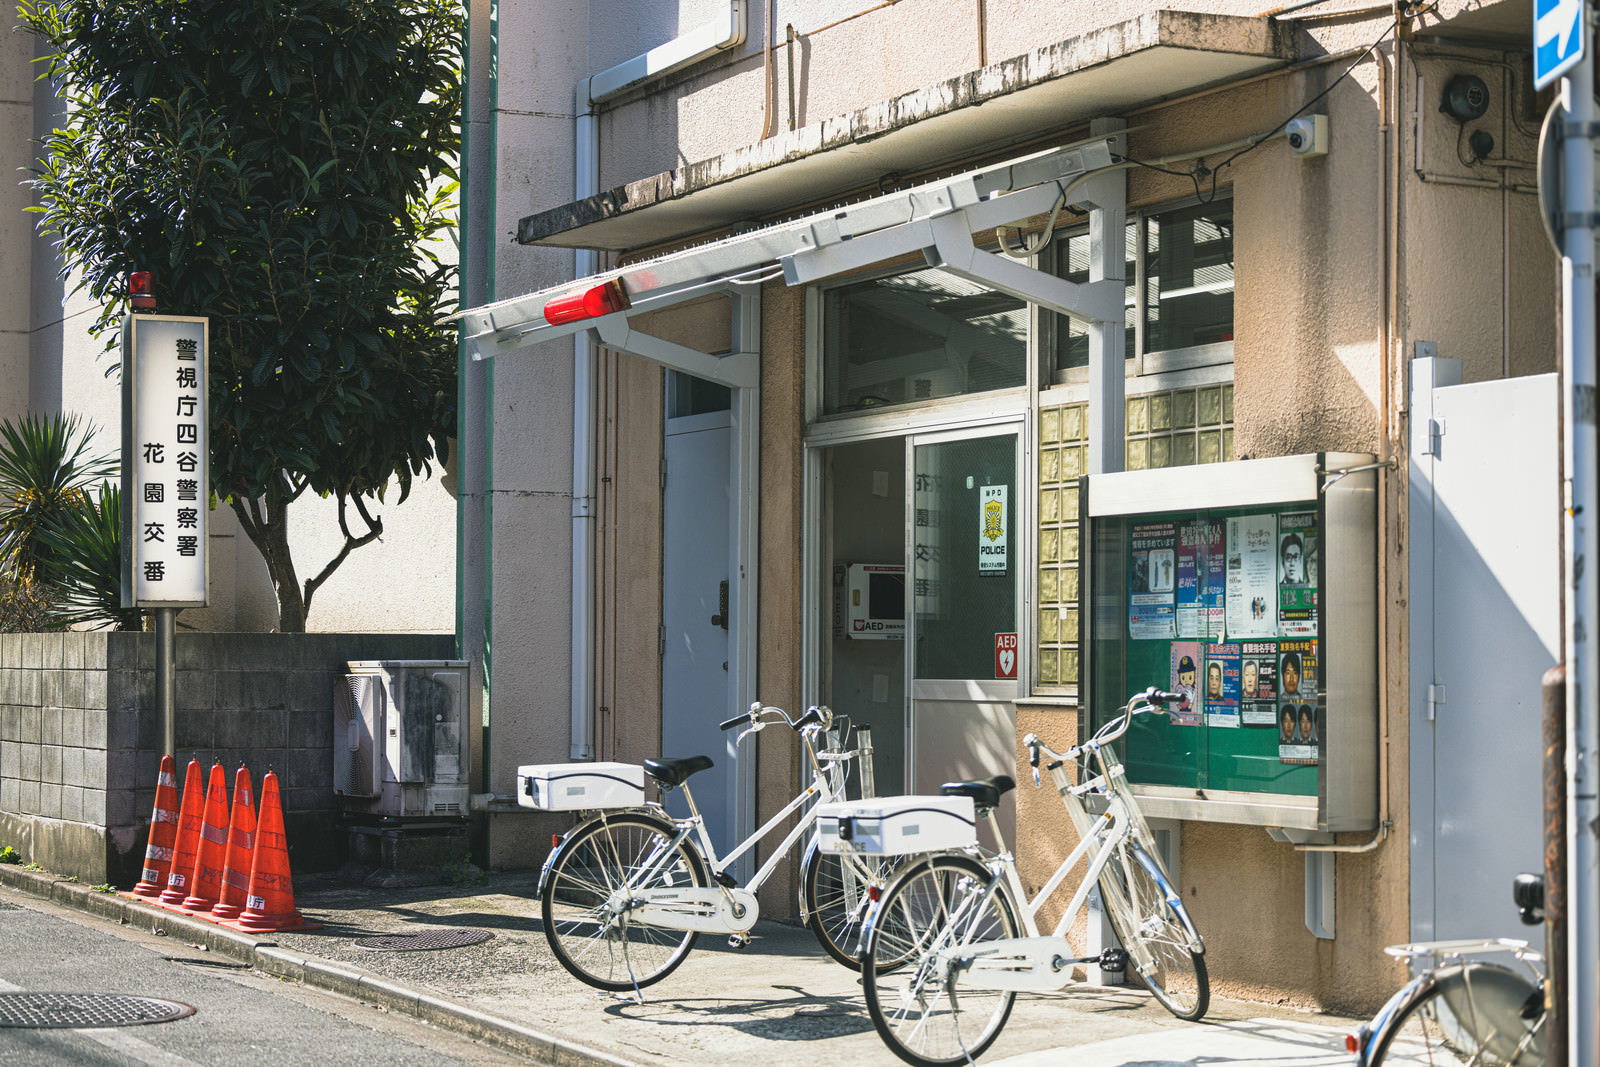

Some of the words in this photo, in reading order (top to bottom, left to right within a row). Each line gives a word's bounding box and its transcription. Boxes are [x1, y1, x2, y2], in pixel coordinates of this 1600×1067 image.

[175, 338, 199, 558] 警視庁四谷警察署
[143, 442, 166, 582] 花園交番
[980, 545, 1006, 555] POLICE
[865, 622, 884, 631] AED
[997, 635, 1017, 649] AED
